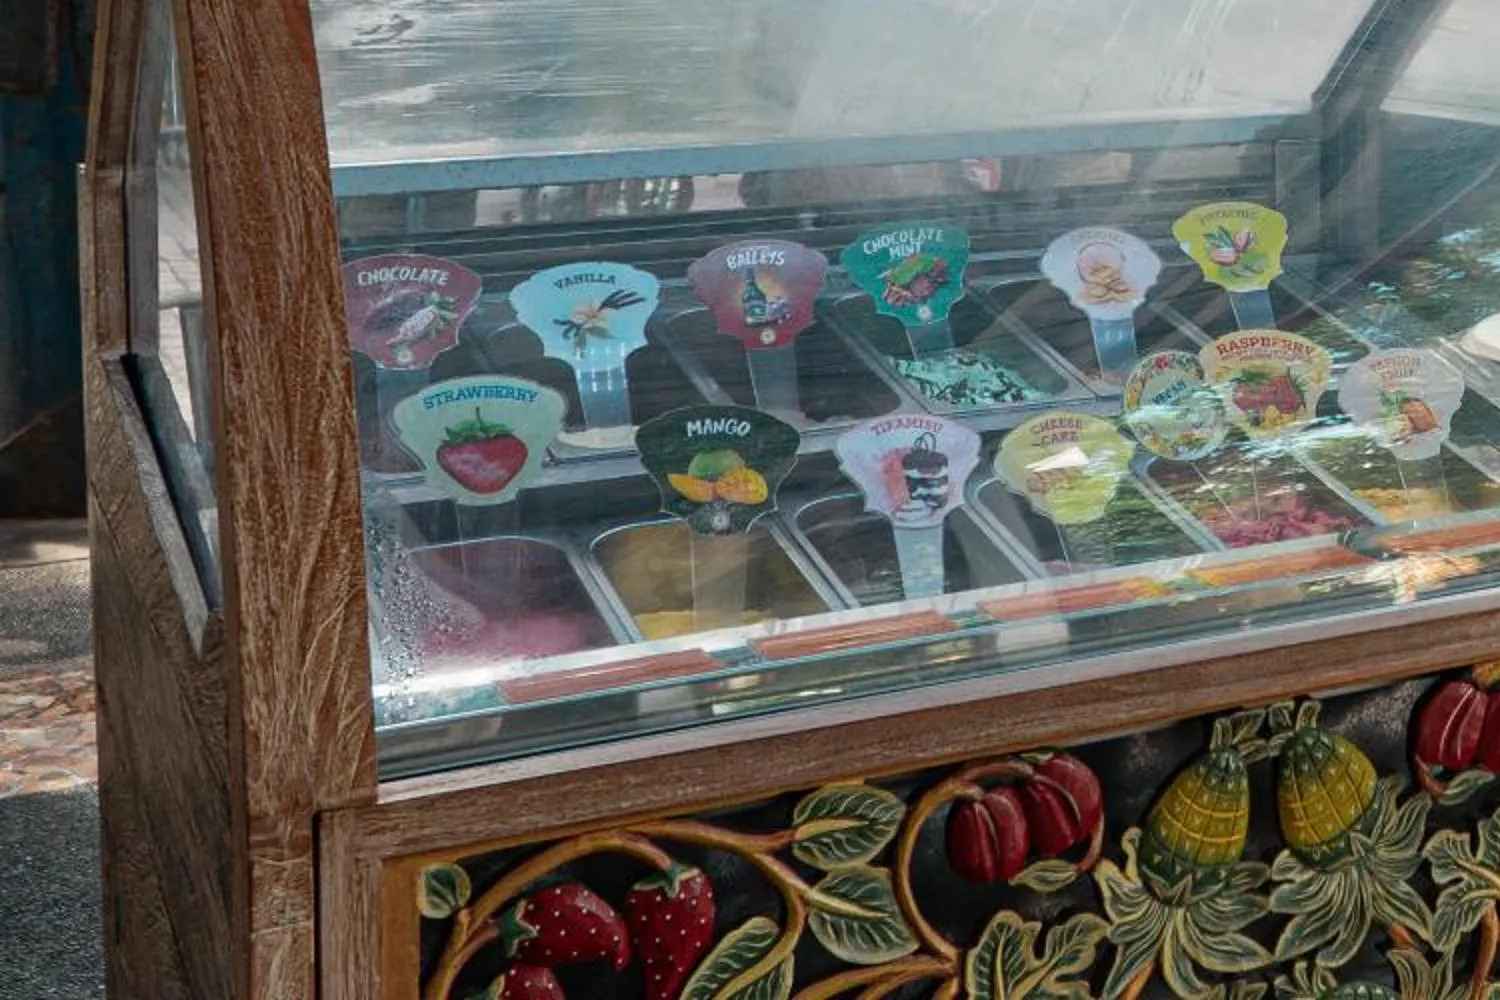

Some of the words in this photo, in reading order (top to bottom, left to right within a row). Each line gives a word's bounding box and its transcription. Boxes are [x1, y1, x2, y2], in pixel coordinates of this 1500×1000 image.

[864, 228, 943, 255] CHOCOLATE
[726, 250, 785, 268] BAILEYS
[357, 267, 449, 285] CHOCOLATE
[553, 274, 616, 289] VANILLA
[423, 385, 539, 409] STRAWBERRY
[687, 418, 751, 437] MANGO
